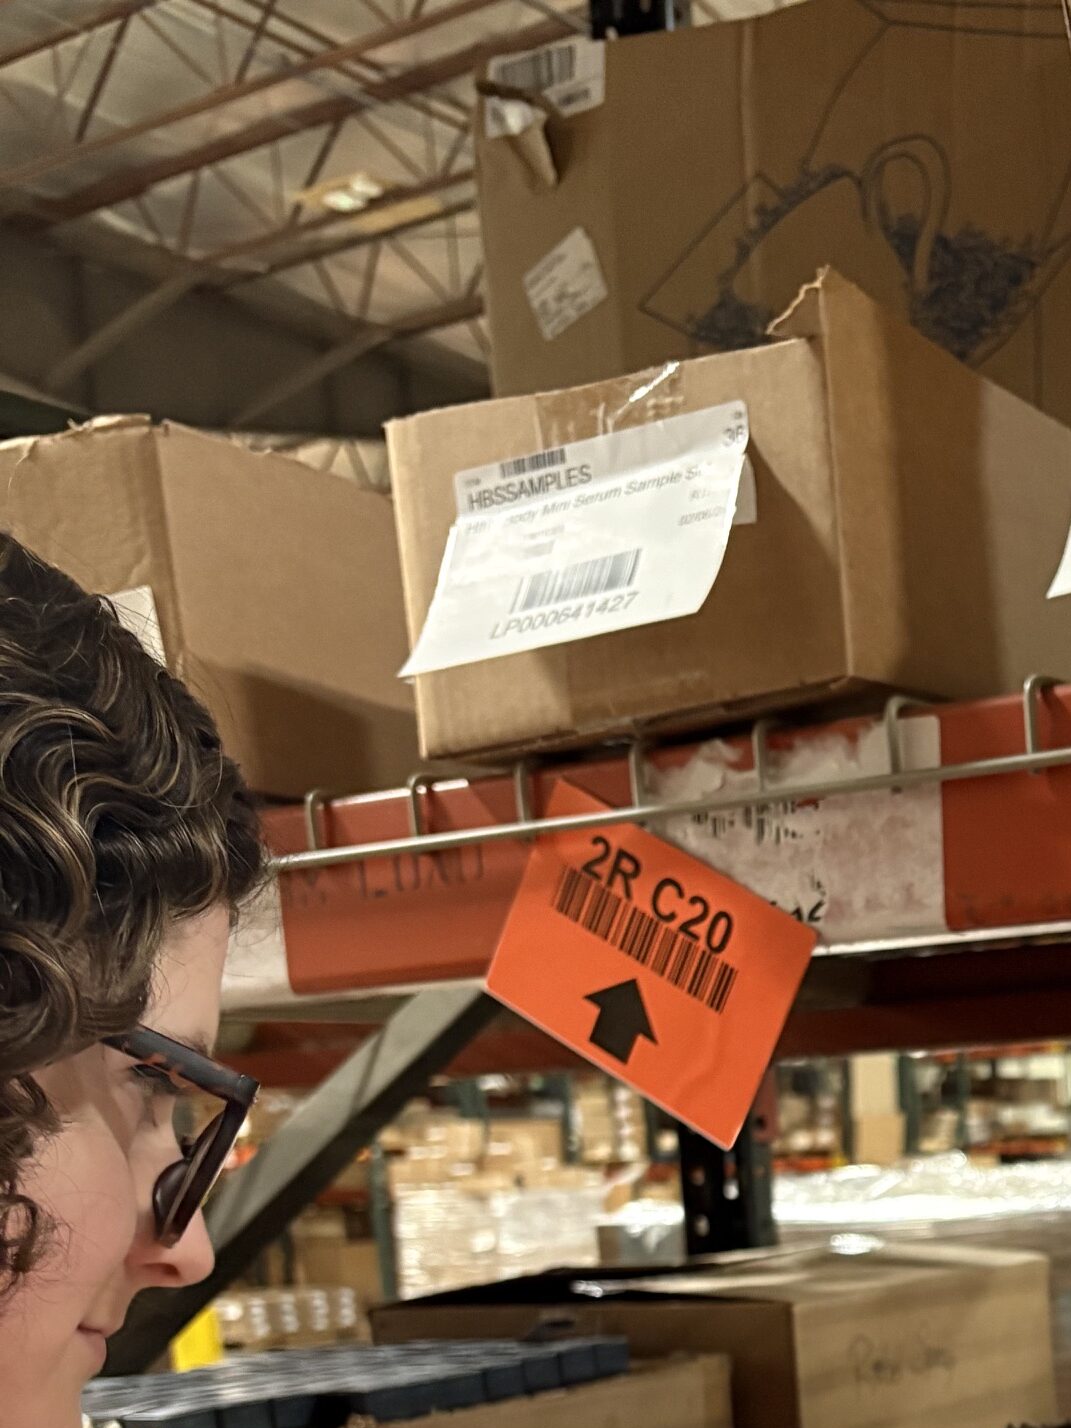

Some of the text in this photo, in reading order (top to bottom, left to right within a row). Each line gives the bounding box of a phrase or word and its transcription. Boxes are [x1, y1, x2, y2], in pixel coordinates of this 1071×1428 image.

[467, 464, 593, 512] HBSSAMPLES
[573, 486, 623, 509] Serum
[623, 470, 683, 497] Sample
[488, 591, 640, 640] LP000641427
[581, 835, 642, 901] 2R
[651, 877, 734, 955] C20
